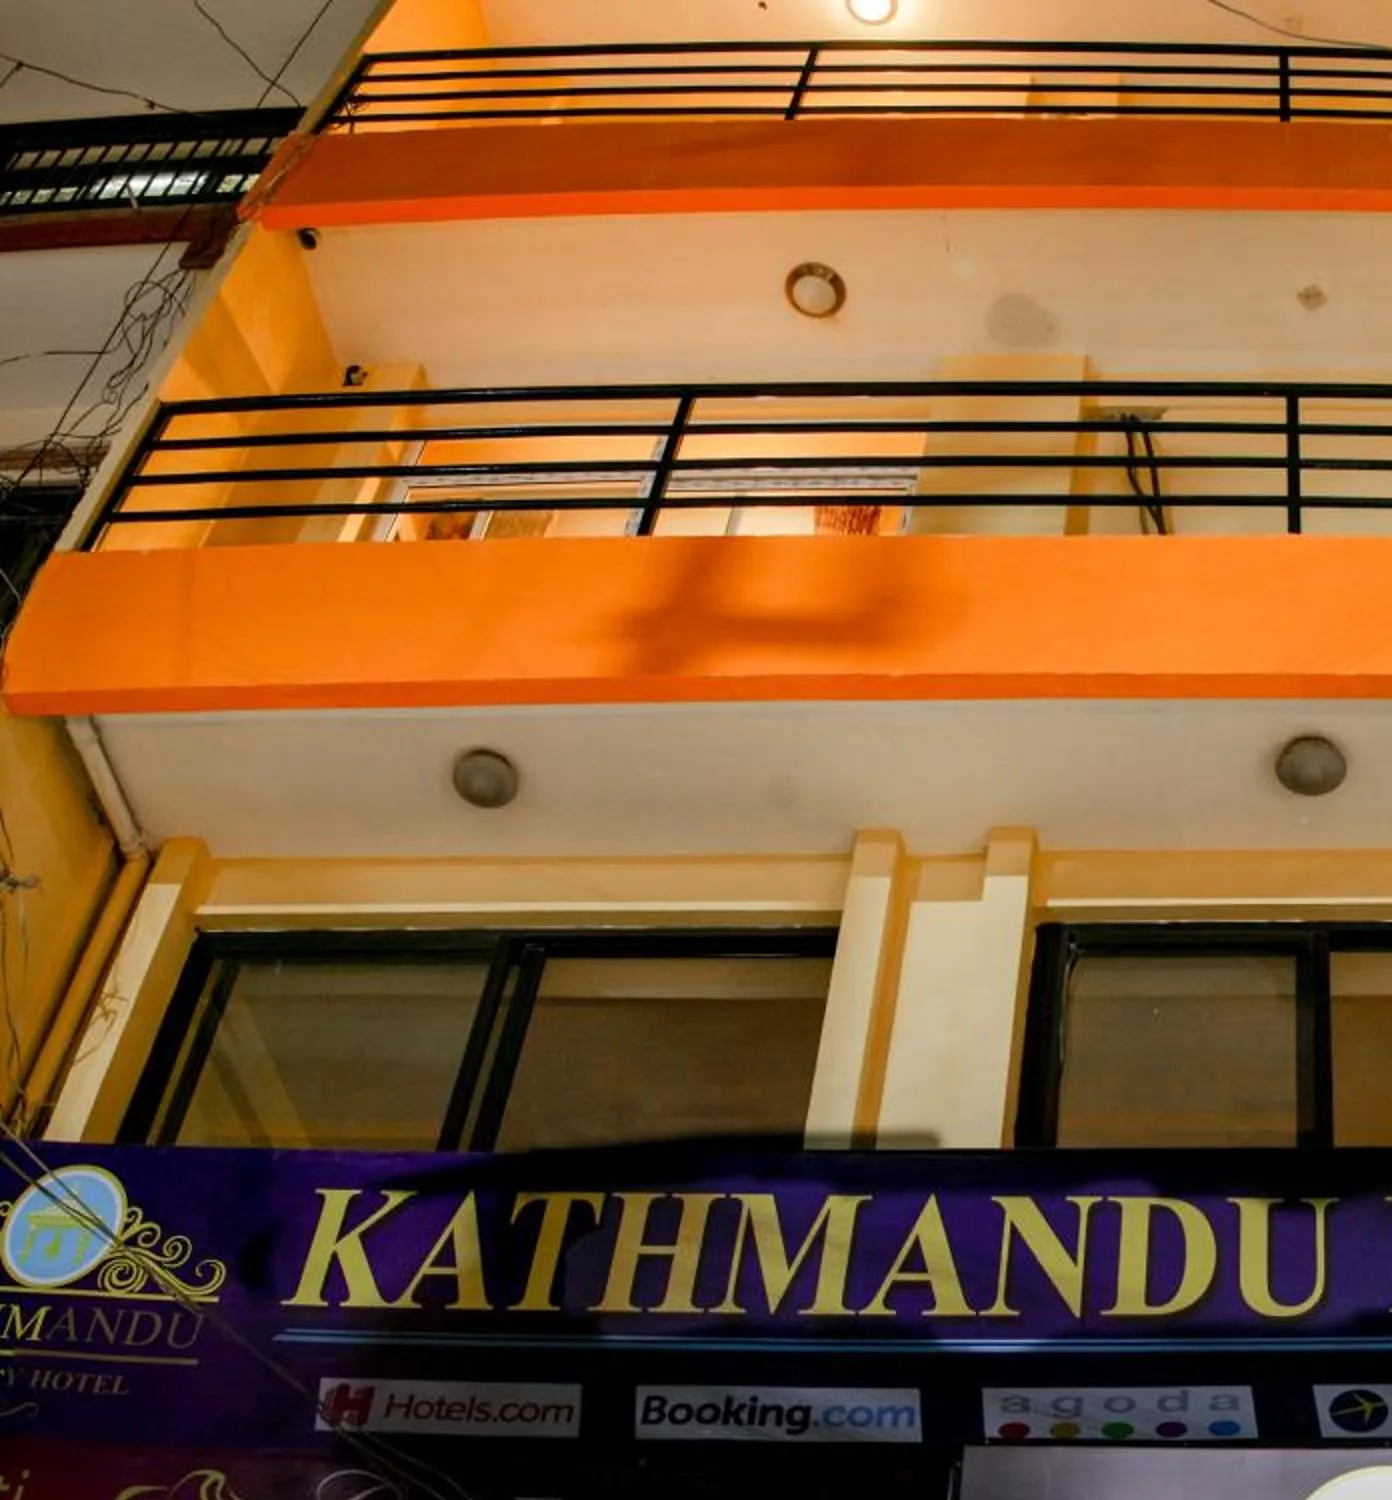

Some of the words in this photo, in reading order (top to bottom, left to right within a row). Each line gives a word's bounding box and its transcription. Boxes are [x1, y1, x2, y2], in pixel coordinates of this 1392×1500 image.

[282, 1188, 1338, 1318] KATHMANDU
[30, 1368, 130, 1395] HOTEL
[384, 1391, 575, 1425] Hotels.com
[640, 1394, 917, 1434] Booking.com
[999, 1388, 1240, 1423] agoda
